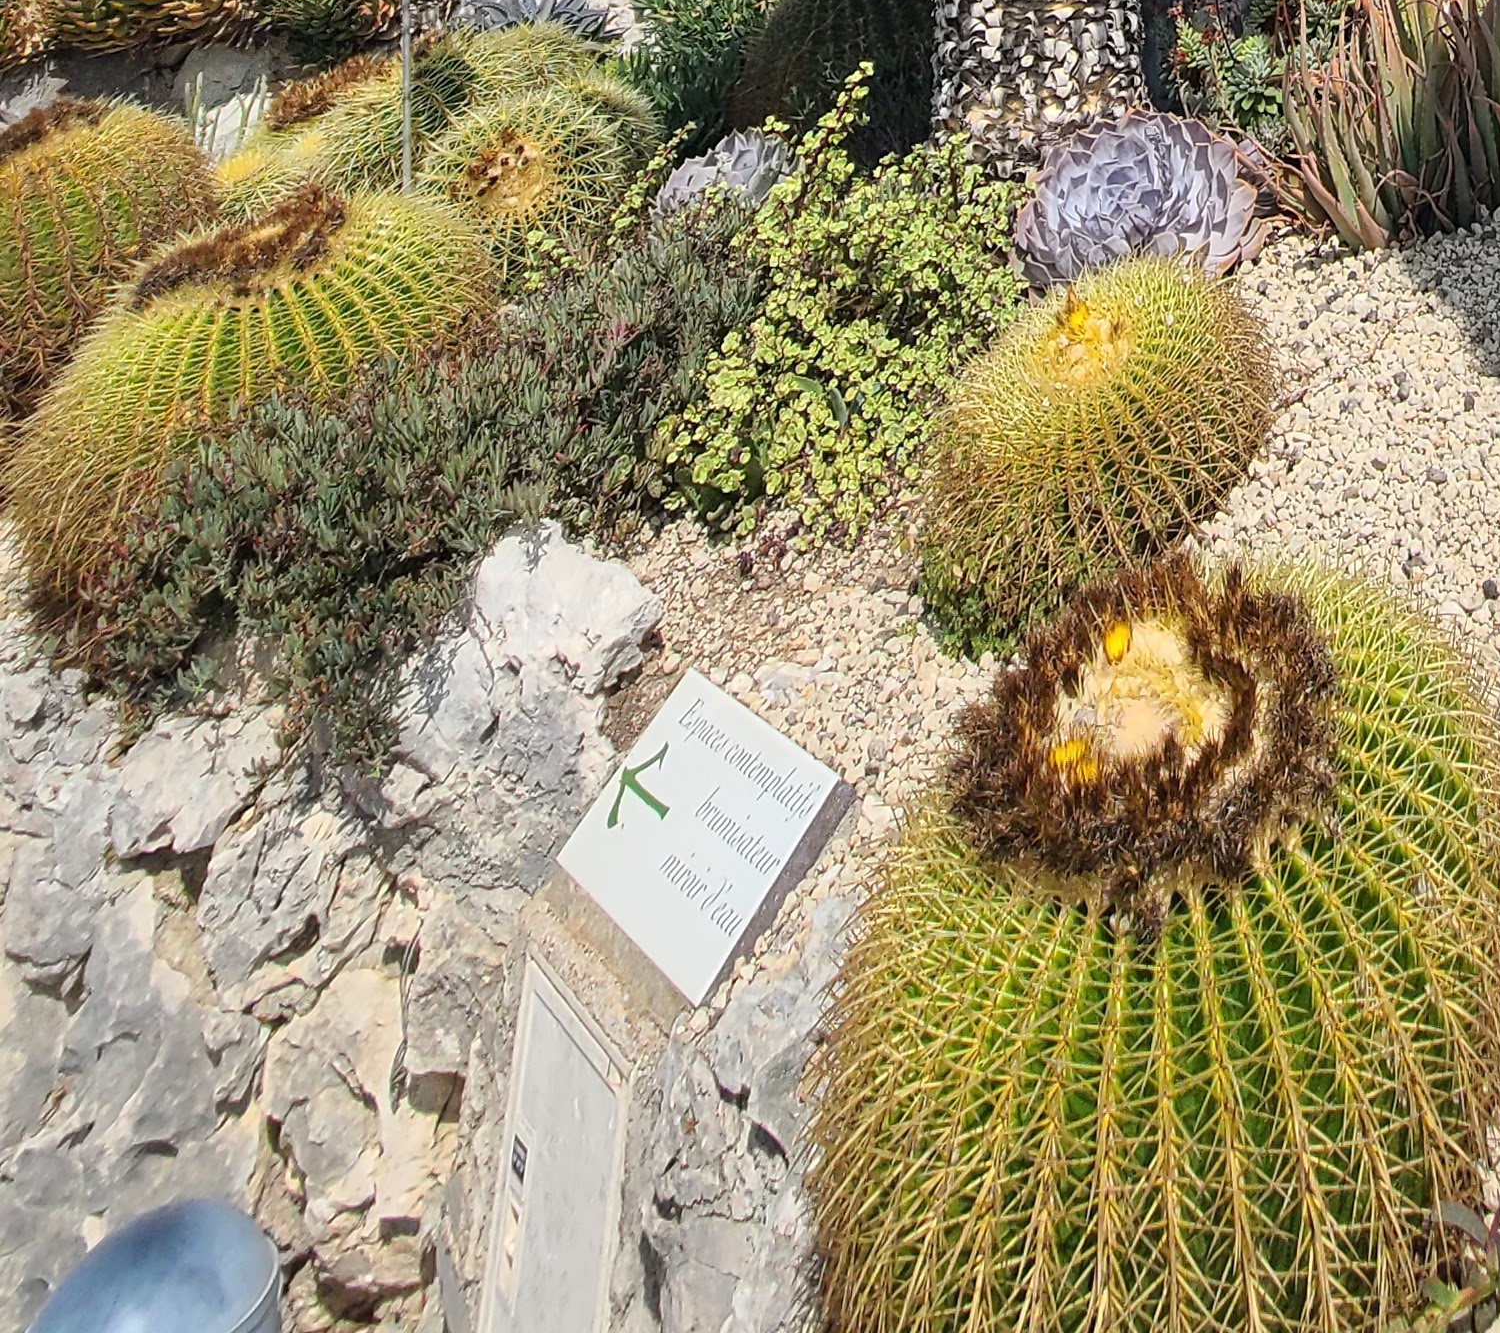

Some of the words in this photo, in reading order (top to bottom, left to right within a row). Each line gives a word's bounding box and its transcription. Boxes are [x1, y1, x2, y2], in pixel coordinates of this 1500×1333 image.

[678, 698, 730, 752] Espaces
[724, 744, 821, 822] contemplatifs
[695, 786, 781, 875] brumisateur
[659, 852, 711, 900] miroir
[701, 877, 743, 937] d'eau
